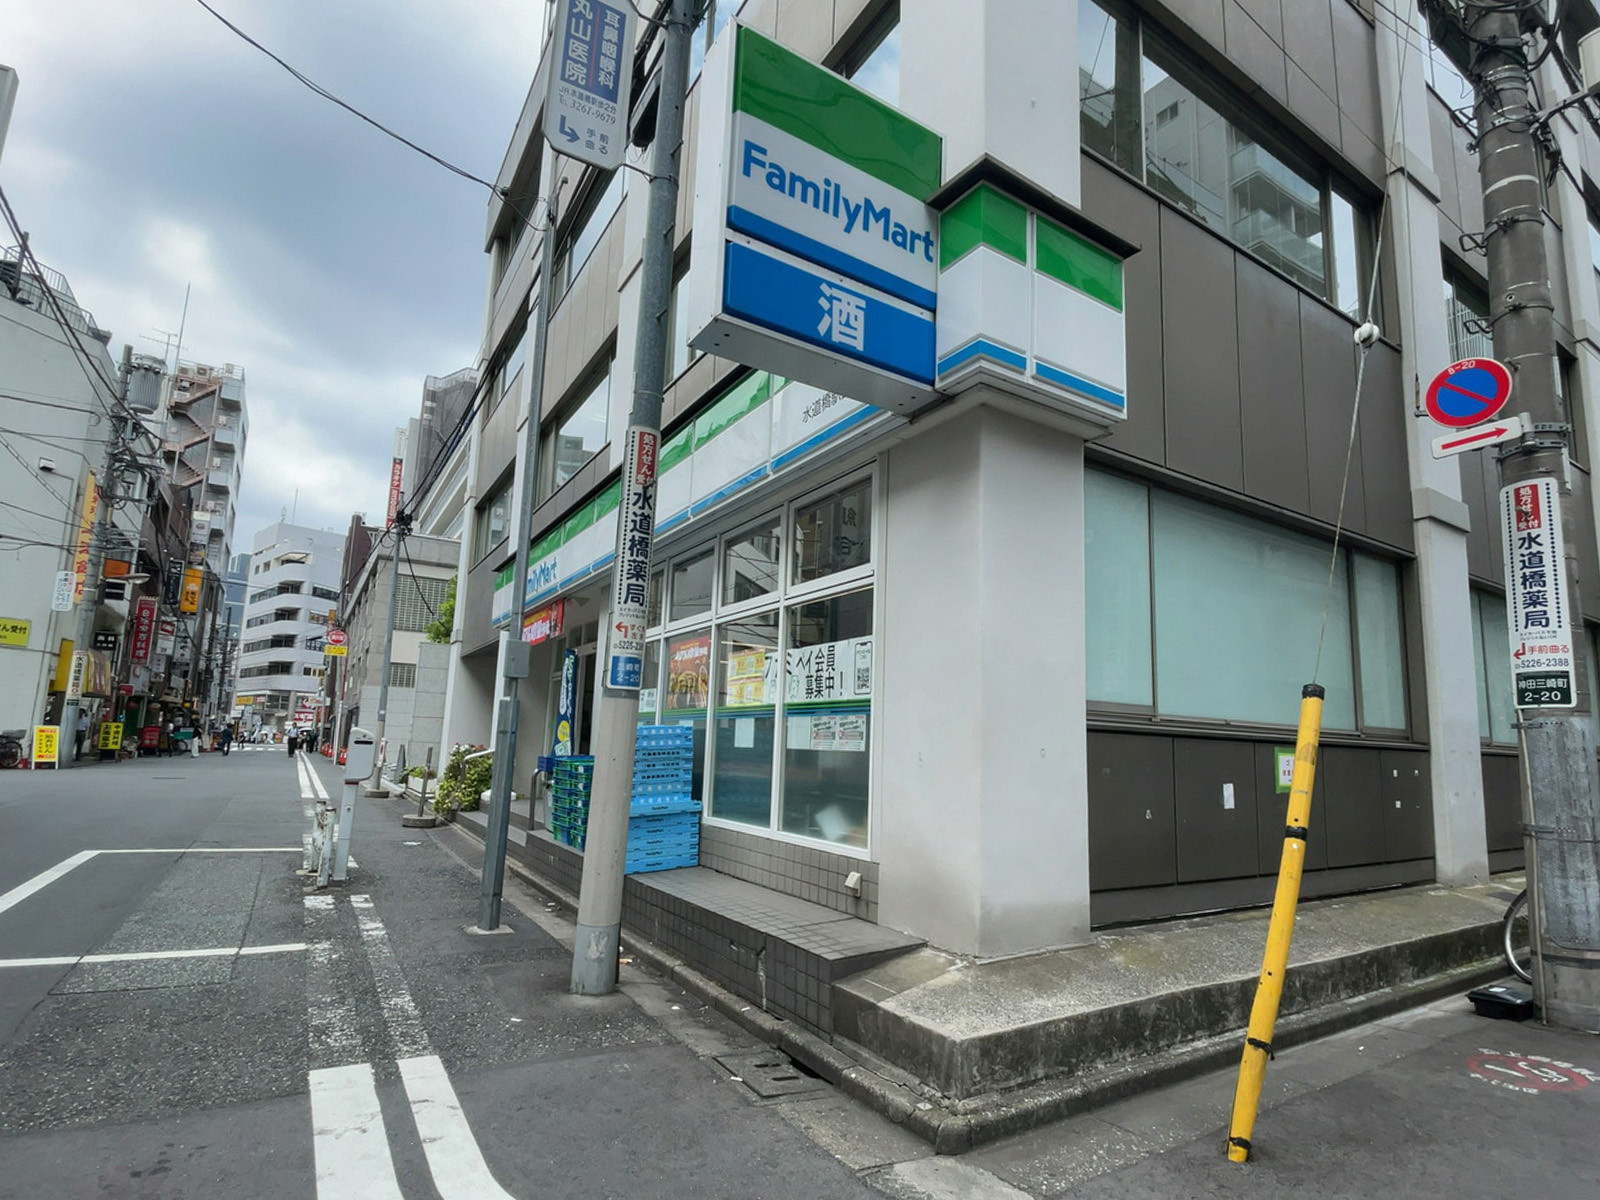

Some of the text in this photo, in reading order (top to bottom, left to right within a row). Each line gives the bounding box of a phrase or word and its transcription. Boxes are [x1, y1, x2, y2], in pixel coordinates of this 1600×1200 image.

[564, 0, 594, 86] 丸山医院
[598, 10, 621, 91] 耳鼻咽喉科
[569, 99, 616, 125] 3261-9679
[584, 139, 609, 155] 曲る
[586, 127, 610, 145] 手前
[742, 140, 935, 263] FamilyMart
[817, 282, 867, 352] 酒
[640, 434, 655, 475] 処方せん
[1518, 519, 1539, 530] 受付
[623, 490, 653, 607] 水道橋薬局
[1518, 532, 1550, 629] 水道橋薬局
[0, 624, 27, 635] ん受付
[1527, 644, 1570, 655] 手前曲る
[764, 645, 836, 679] フミペイ会員
[1520, 658, 1570, 669] 5226-2388
[616, 673, 640, 684] 2-20
[1517, 678, 1568, 689] 神田三崎町
[1524, 690, 1562, 702] 2-20
